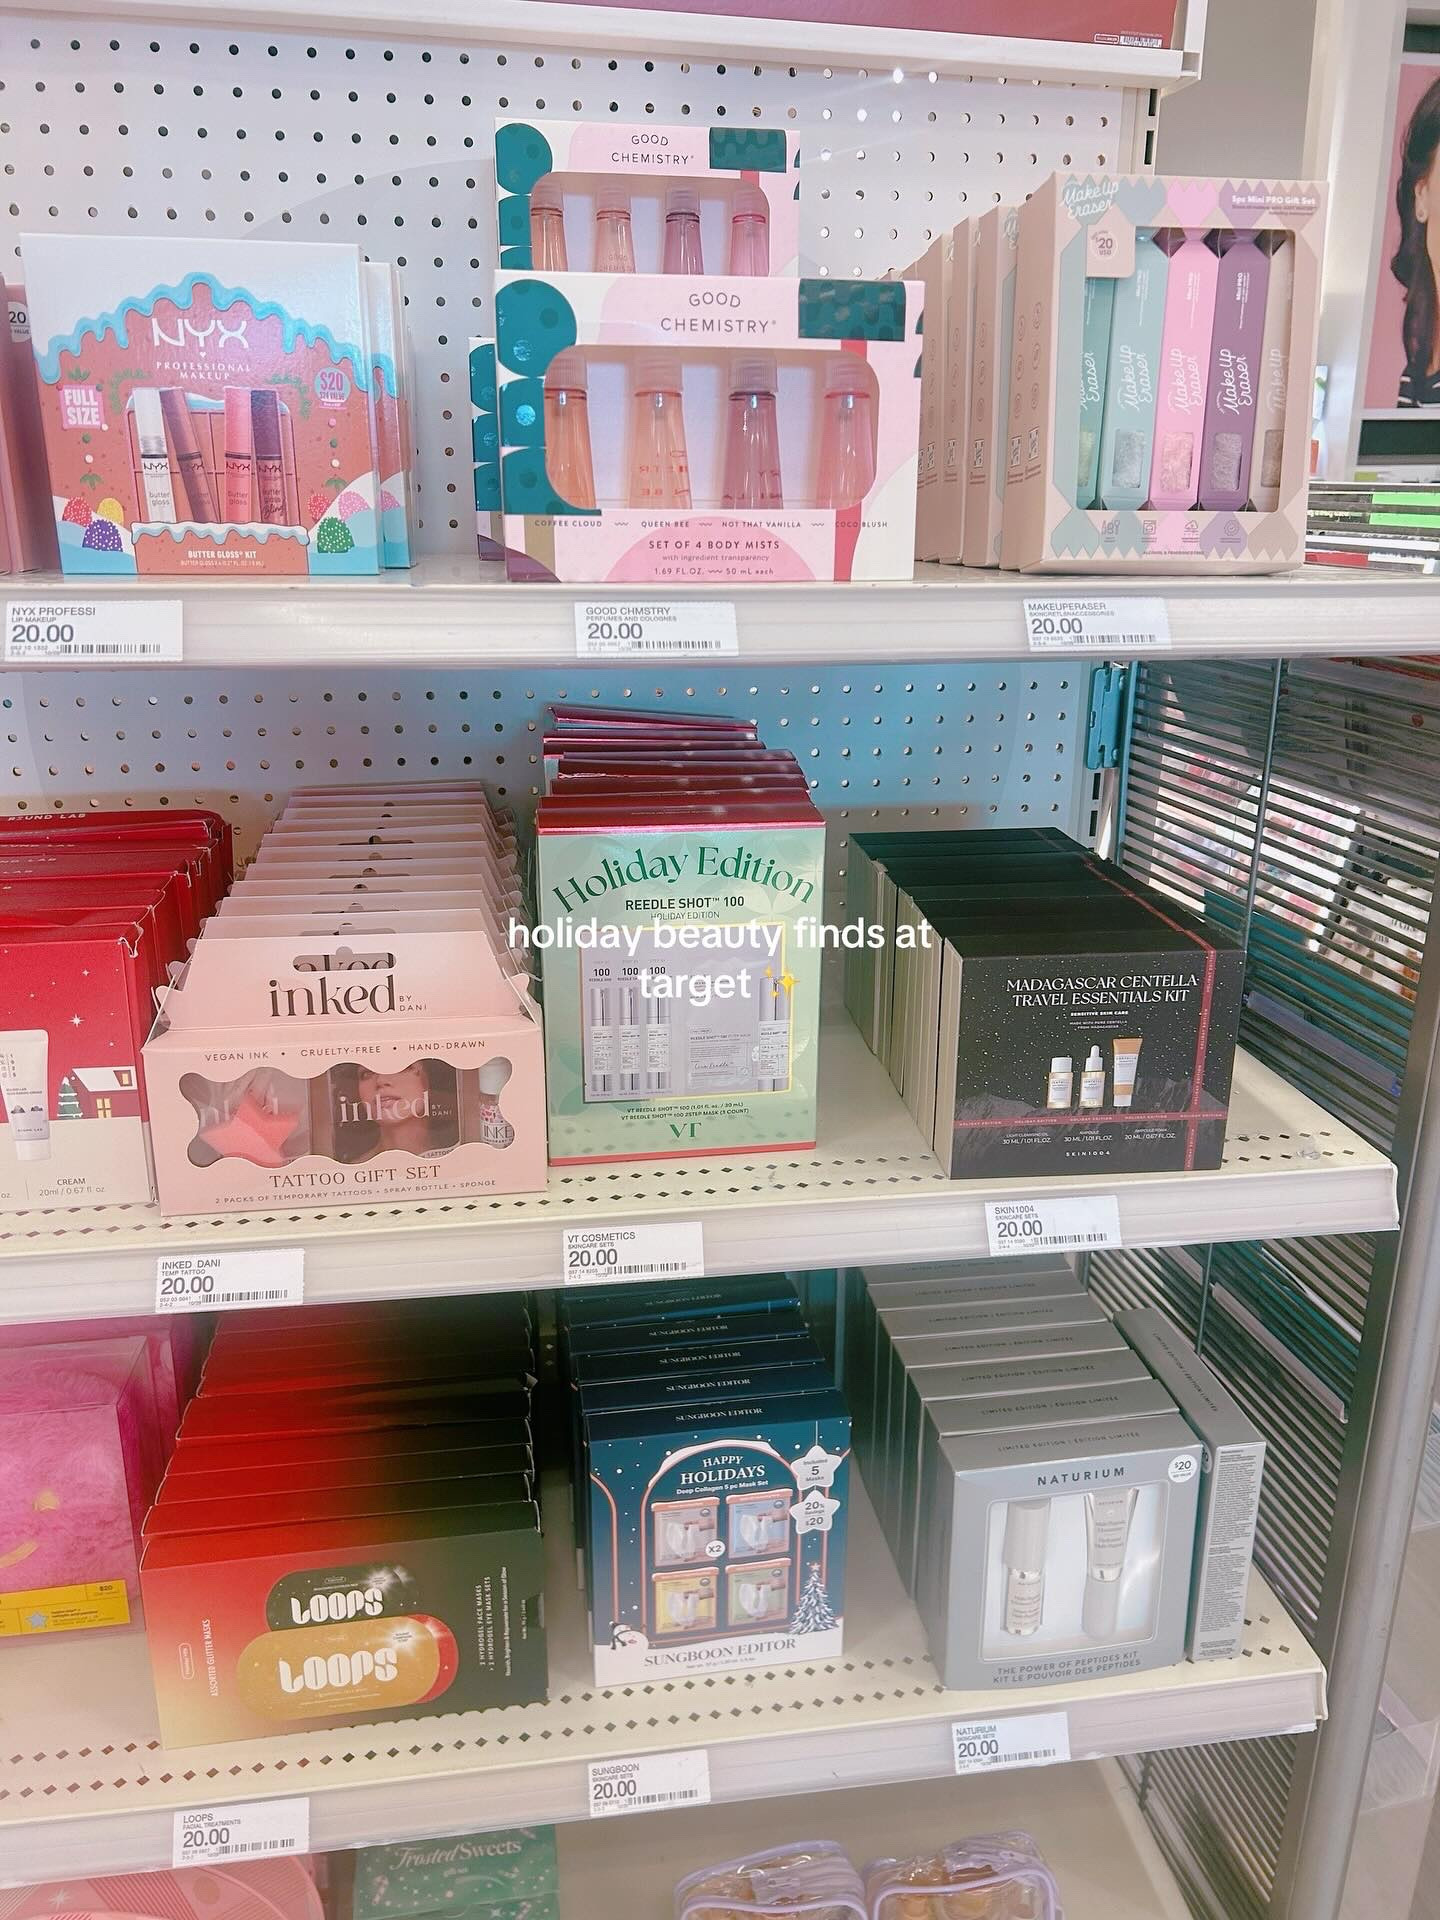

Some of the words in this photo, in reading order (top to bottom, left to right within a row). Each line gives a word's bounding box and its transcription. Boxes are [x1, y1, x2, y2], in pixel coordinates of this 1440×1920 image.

[631, 134, 669, 146] GOOD
[1068, 199, 1112, 219] Eraser
[689, 292, 741, 308] GOOD
[152, 318, 249, 348] NYX
[156, 361, 250, 372] PROFESSIONAL
[180, 371, 229, 381] MAKEUP
[1236, 356, 1252, 407] Eraser
[64, 389, 98, 406] FULL
[67, 407, 100, 425] SIZE
[143, 462, 169, 471] NYX
[226, 462, 251, 470] NYX
[534, 519, 569, 527] COFFEE
[571, 520, 603, 528] CLOUD
[641, 520, 671, 529] QUEEN
[673, 520, 690, 528] BEE
[765, 521, 802, 529] VANILLA
[834, 521, 859, 529] COCO
[861, 521, 888, 529] BLUSH
[649, 540, 669, 550] SET
[675, 540, 690, 550] OF
[695, 539, 702, 550] 4
[708, 540, 740, 549] BODY
[745, 540, 780, 549] MISTS
[187, 550, 216, 559] BUTTER
[245, 550, 257, 559] KIT
[661, 553, 680, 561] with
[681, 554, 719, 562] ingredient
[721, 554, 770, 563] transparency
[654, 567, 672, 575] 1.69
[725, 567, 737, 576] 50
[12, 607, 35, 616] NYX
[39, 607, 96, 616] PROFESSI
[586, 607, 617, 615] GOOD
[620, 607, 671, 615] CHMSTRY
[1028, 602, 1106, 611] MAKEUPERASER
[588, 623, 642, 639] 20.00
[1031, 618, 1082, 634] 20.00
[12, 624, 74, 643] 20.00
[552, 848, 689, 913] Holiday
[697, 846, 816, 903] Edition
[625, 899, 676, 911] REEDLE
[723, 896, 745, 907] 100
[650, 913, 685, 921] HOLIDAY
[687, 911, 720, 920] EDITION
[593, 968, 611, 977] 100
[622, 967, 639, 976] 100
[649, 966, 666, 975] 100
[1006, 977, 1116, 991] MADAGASCAR
[1120, 974, 1197, 989] CENTELLA
[269, 974, 396, 1017] inked
[1013, 993, 1069, 1007] TRAVEL
[1072, 991, 1162, 1005] ESSENTIALS
[1164, 989, 1190, 1002] KIT
[399, 1004, 428, 1012] DANI
[205, 1052, 244, 1062] VEGAN
[249, 1051, 269, 1060] INK
[300, 1045, 382, 1057] CRUELTY-FREE
[408, 1040, 486, 1051] HAND-DRAWN
[340, 1091, 431, 1123] inked
[670, 1122, 702, 1138] VT
[56, 1178, 86, 1186] CREAM
[269, 1172, 346, 1189] TATTOO
[353, 1168, 397, 1184] GIFT
[405, 1165, 442, 1180] SET
[224, 1195, 255, 1204] PACKS
[257, 1194, 270, 1202] OF
[273, 1191, 328, 1201] TEMPORARY
[332, 1189, 373, 1197] TATTOOS
[383, 1185, 412, 1194] SPRAY
[415, 1183, 450, 1192] BOTTLE
[459, 1179, 497, 1188] SPONGE
[995, 1205, 1034, 1215] SKIN1004
[997, 1220, 1042, 1237] 20.00
[567, 1234, 579, 1243] VT
[582, 1232, 635, 1242] COSMETICS
[567, 1242, 598, 1250] SKINCARE
[162, 1261, 192, 1270] INKED
[197, 1259, 221, 1268] DANI
[569, 1249, 618, 1267] 20.00
[180, 1268, 206, 1276] TATTOO
[161, 1276, 214, 1295] 20.00
[675, 1411, 726, 1421] SUNGBOON
[728, 1408, 764, 1417] EDITOR
[703, 1456, 743, 1467] HAPPY
[1174, 1460, 1192, 1472] $20
[680, 1465, 765, 1485] HOLIDAYS
[811, 1465, 820, 1475] 5
[1037, 1467, 1125, 1485] NATURIUM
[676, 1487, 694, 1495] Deep
[694, 1485, 724, 1494] Collagen
[738, 1481, 756, 1489] Mask
[290, 1588, 384, 1625] LOOPS
[644, 1646, 733, 1667] SUNGBOON
[738, 1637, 796, 1656] EDITOR
[997, 1667, 1016, 1675] THE
[1020, 1663, 1055, 1673] POWER
[1058, 1660, 1072, 1669] OF
[1075, 1655, 1120, 1666] PEPTIDES
[1123, 1651, 1138, 1660] KIT
[279, 1648, 398, 1693] LOOPS
[992, 1675, 1010, 1684] KIT
[1012, 1674, 1023, 1682] LE
[1027, 1670, 1072, 1680] POUVOIR
[1075, 1667, 1093, 1675] DES
[1096, 1659, 1141, 1672] PEPTIDES
[956, 1725, 997, 1736] NATURIUM
[958, 1740, 999, 1758] 20.00
[592, 1763, 640, 1776] SUNGBOON
[593, 1780, 636, 1800] 20.00
[182, 1823, 203, 1831] FACIAL
[204, 1819, 241, 1828] TREATMENTS
[183, 1813, 213, 1823] LOOPS
[183, 1828, 230, 1848] 20.00
[459, 1840, 522, 1860] Sweets
